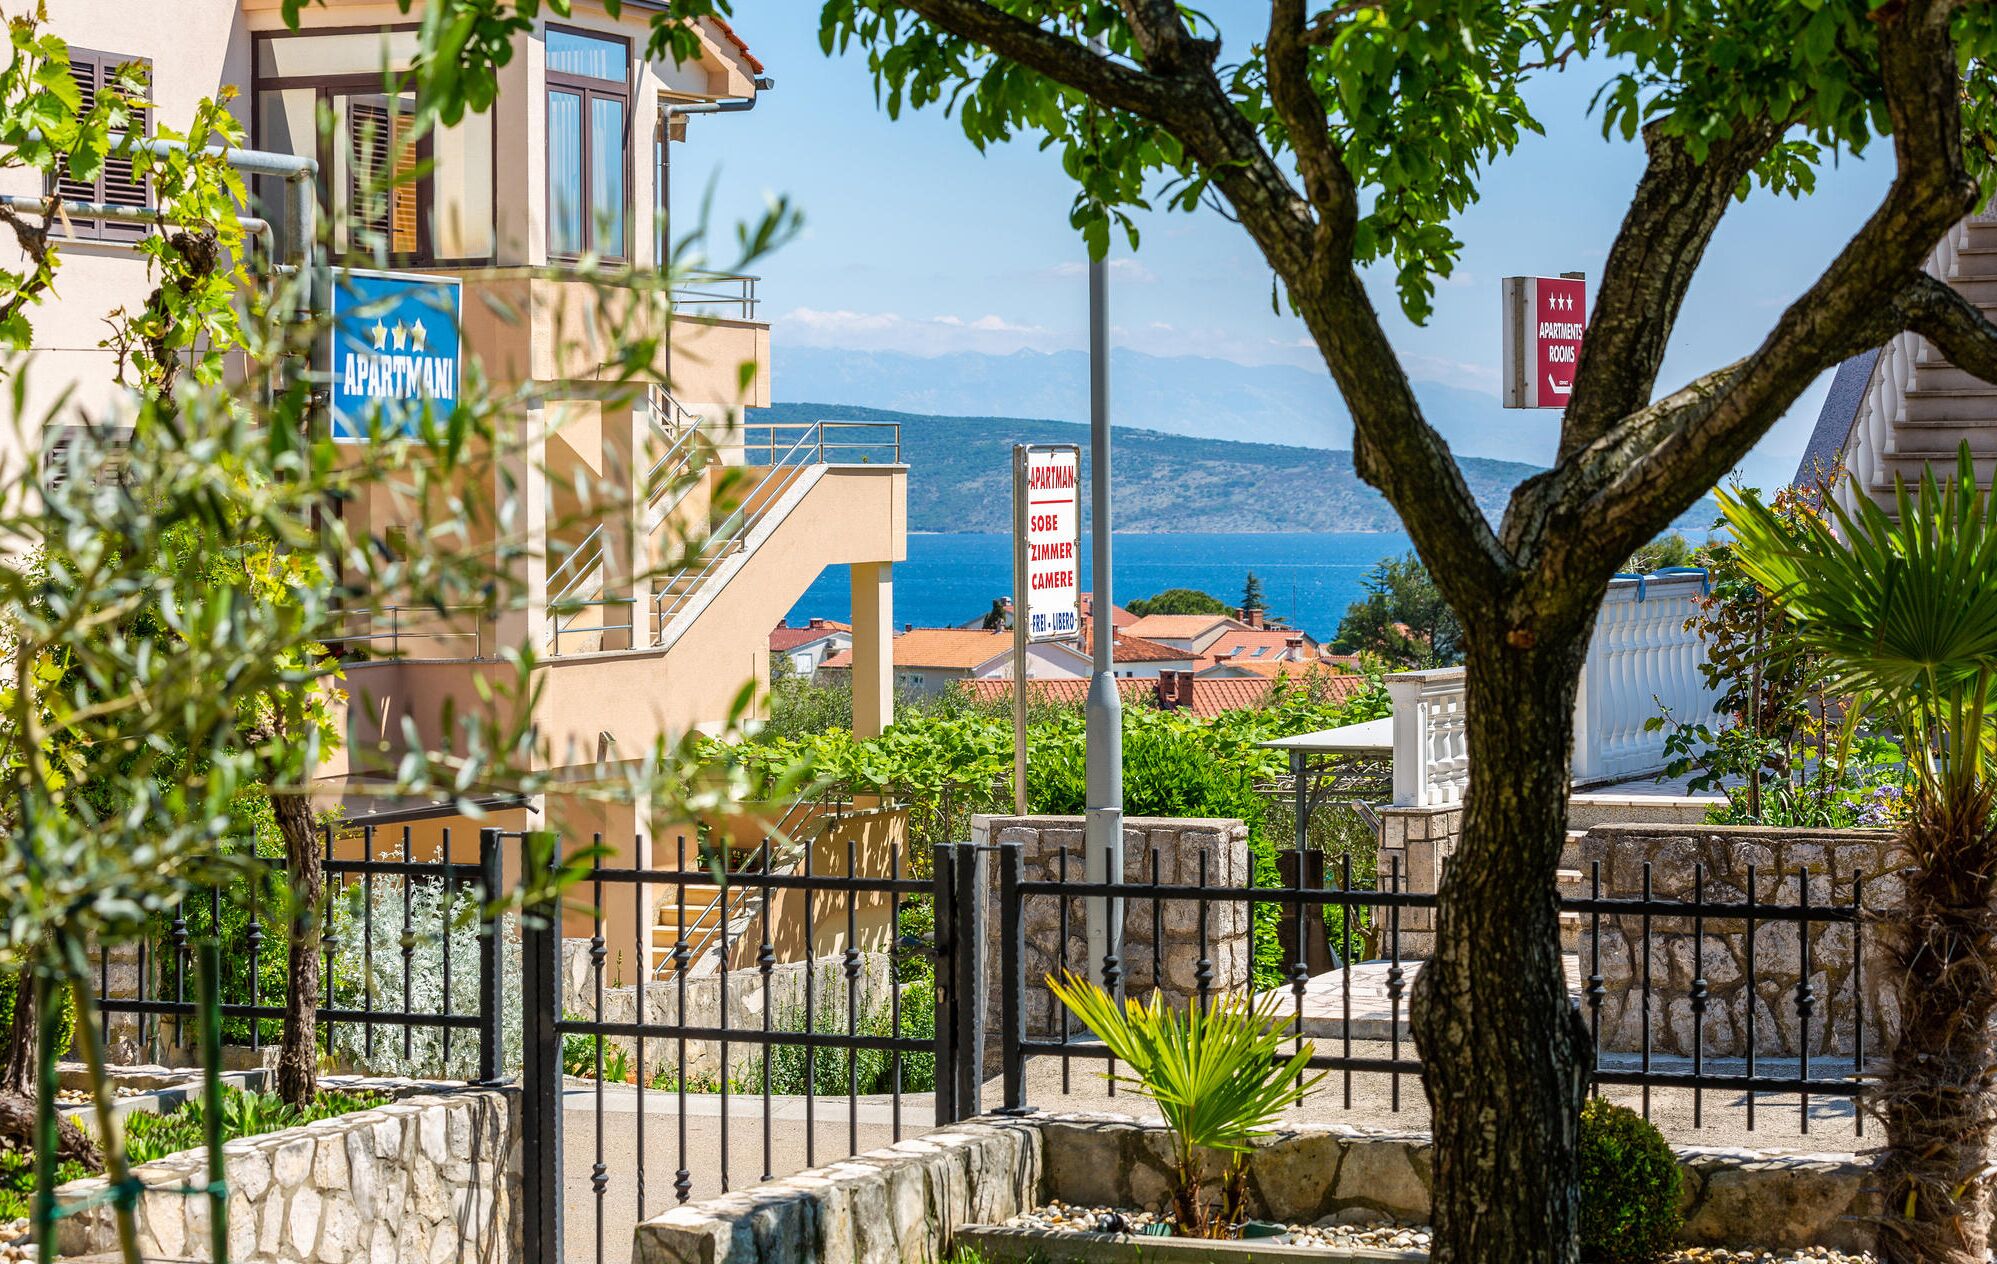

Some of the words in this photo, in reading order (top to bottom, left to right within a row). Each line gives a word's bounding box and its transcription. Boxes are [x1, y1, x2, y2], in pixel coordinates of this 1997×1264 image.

[1539, 322, 1583, 341] APARTMENTS
[1549, 345, 1575, 363] ROOMS
[343, 352, 453, 400] APARTMANI
[1030, 465, 1074, 490] APARTMAN
[1030, 514, 1058, 533] SOBE
[1031, 541, 1073, 561] ZIMMER
[1031, 570, 1073, 590] CAMERE
[1032, 614, 1047, 633] FREI
[1052, 611, 1075, 631] LIBERO
